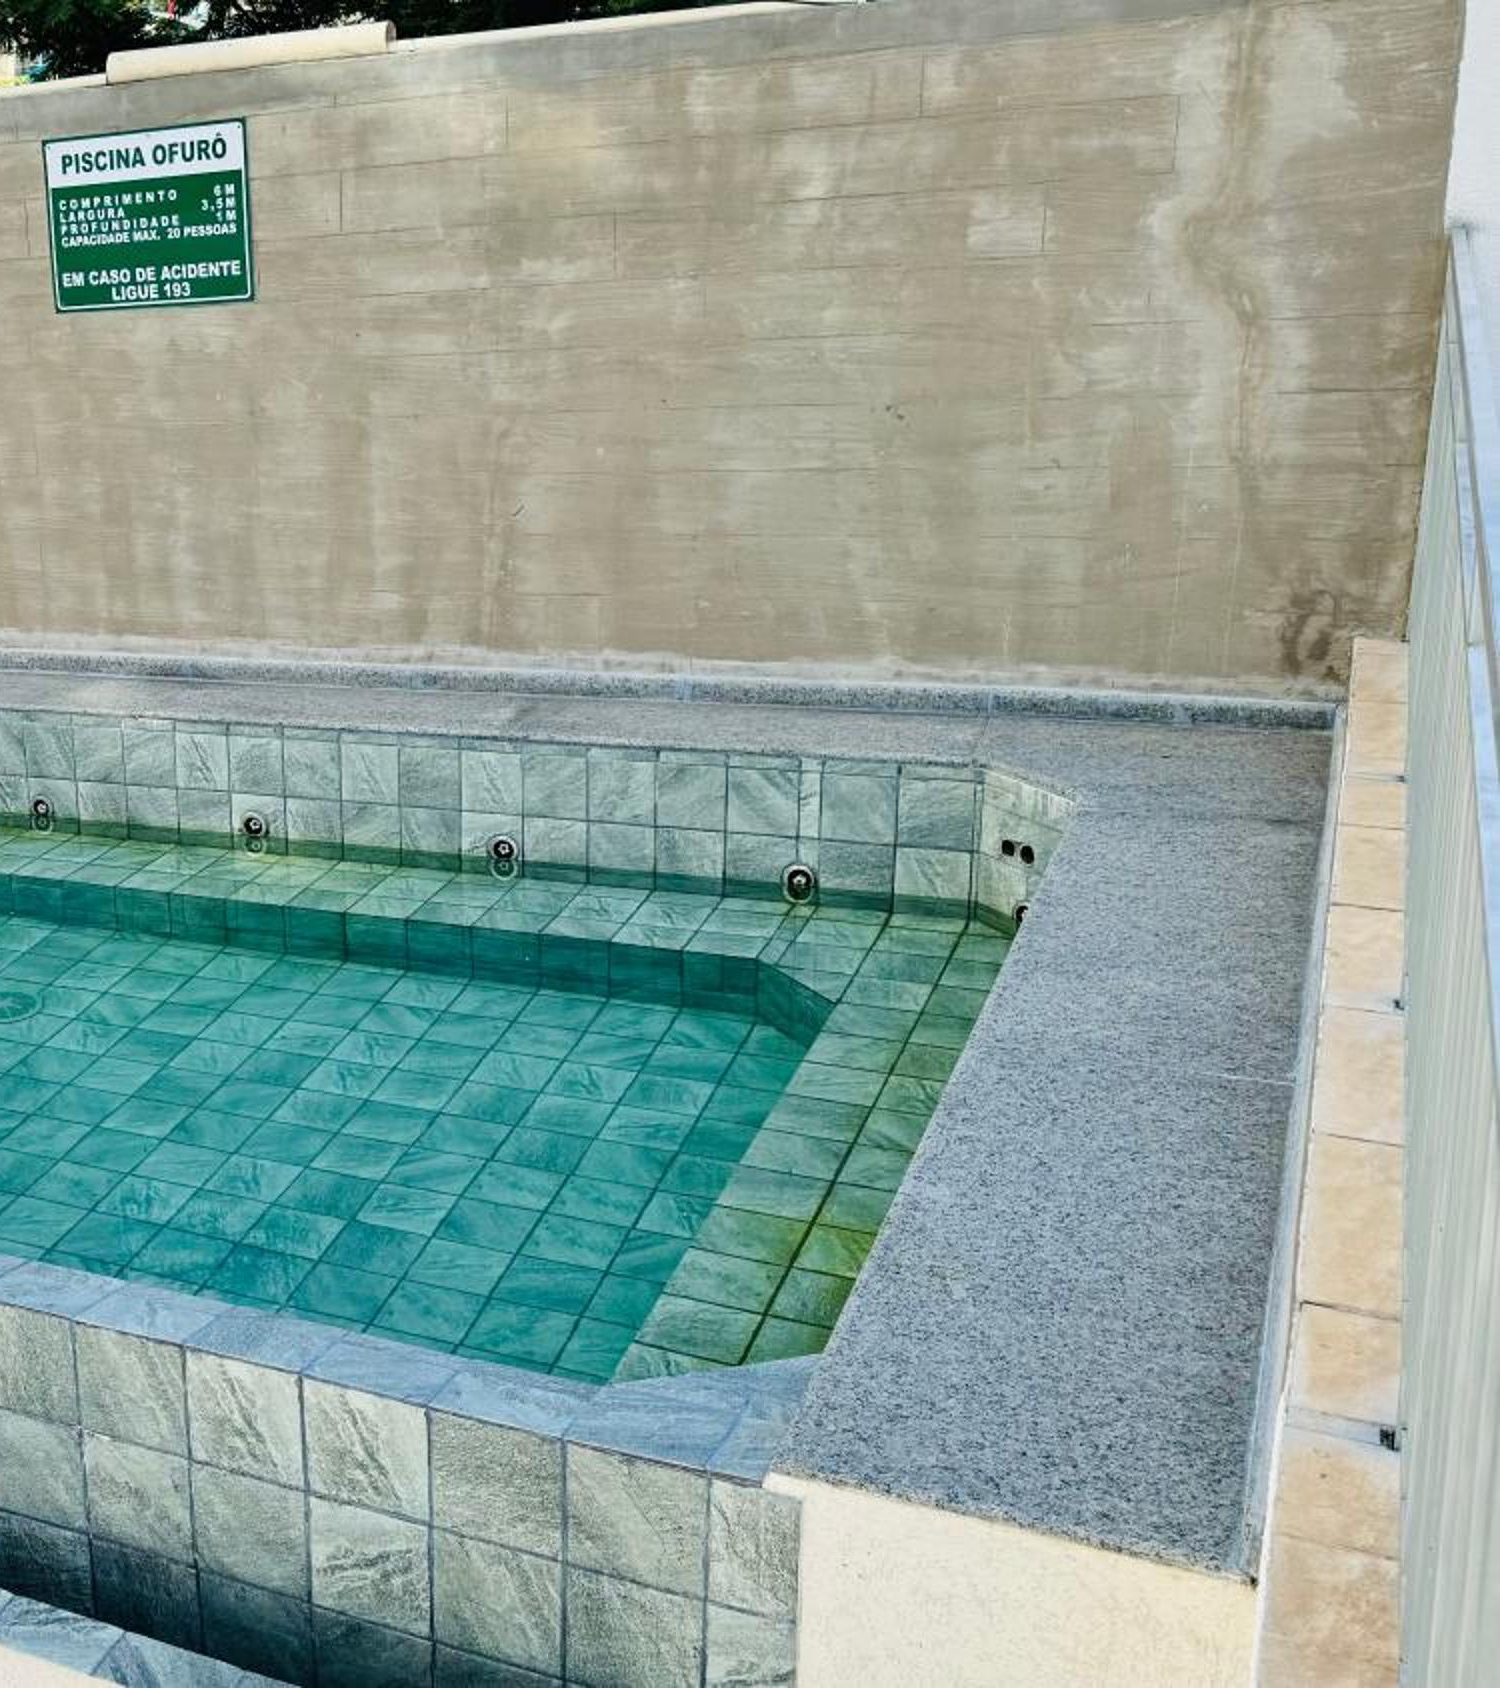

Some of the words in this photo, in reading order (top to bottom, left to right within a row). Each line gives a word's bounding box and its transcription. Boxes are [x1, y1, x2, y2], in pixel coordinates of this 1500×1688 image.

[61, 147, 146, 175] PISCINA
[152, 132, 226, 165] OFURÔ
[59, 189, 177, 211] COMPRIMENTO
[59, 208, 125, 223] LARGURA
[61, 215, 179, 235] PROFUNDIDADE
[61, 232, 130, 248] CAPACIDADE
[133, 229, 161, 245] MAX.
[167, 227, 181, 239] 20
[183, 222, 237, 237] PESSOAS
[62, 272, 84, 287] EM
[88, 269, 131, 285] CASO
[135, 267, 157, 281] DE
[161, 260, 241, 280] ACIDENTE
[112, 284, 159, 300] LIGUE
[164, 282, 191, 296] 193
